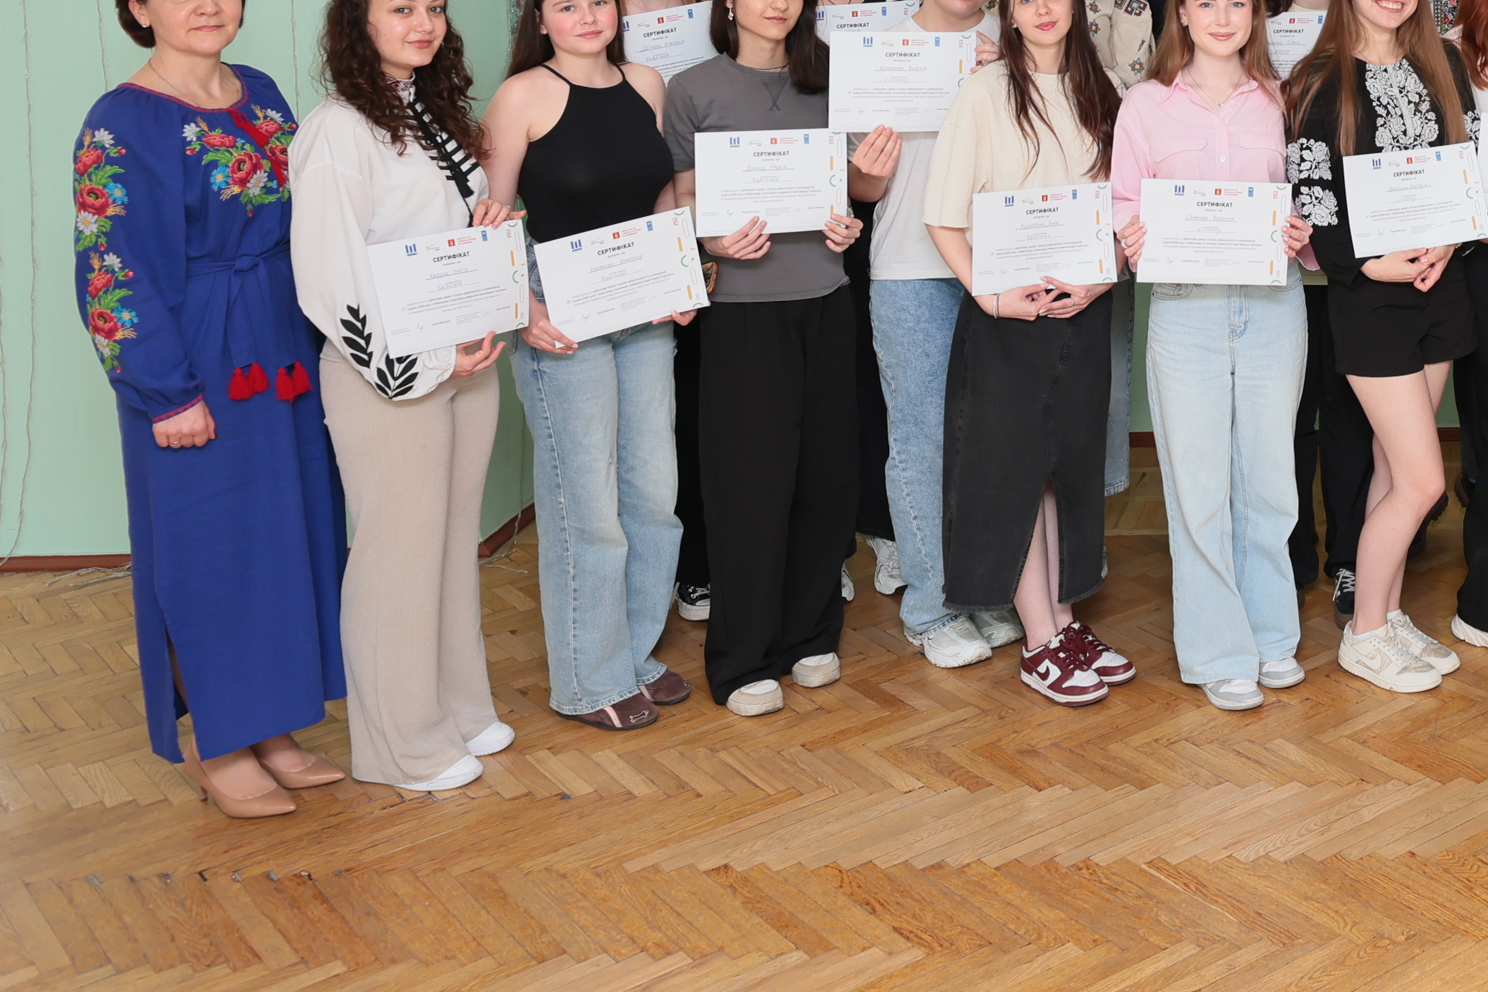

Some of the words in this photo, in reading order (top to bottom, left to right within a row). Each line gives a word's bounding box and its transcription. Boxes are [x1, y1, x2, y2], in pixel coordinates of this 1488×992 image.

[643, 27, 677, 38] СЕРТИФІКАТ
[1393, 169, 1425, 178] СЕРТИФІКАТ
[1025, 207, 1059, 215] СЕРТИФІКАТ
[597, 241, 635, 256] СЕРТИФІКАТ
[432, 251, 470, 264] СЕРТИФІКАТ
